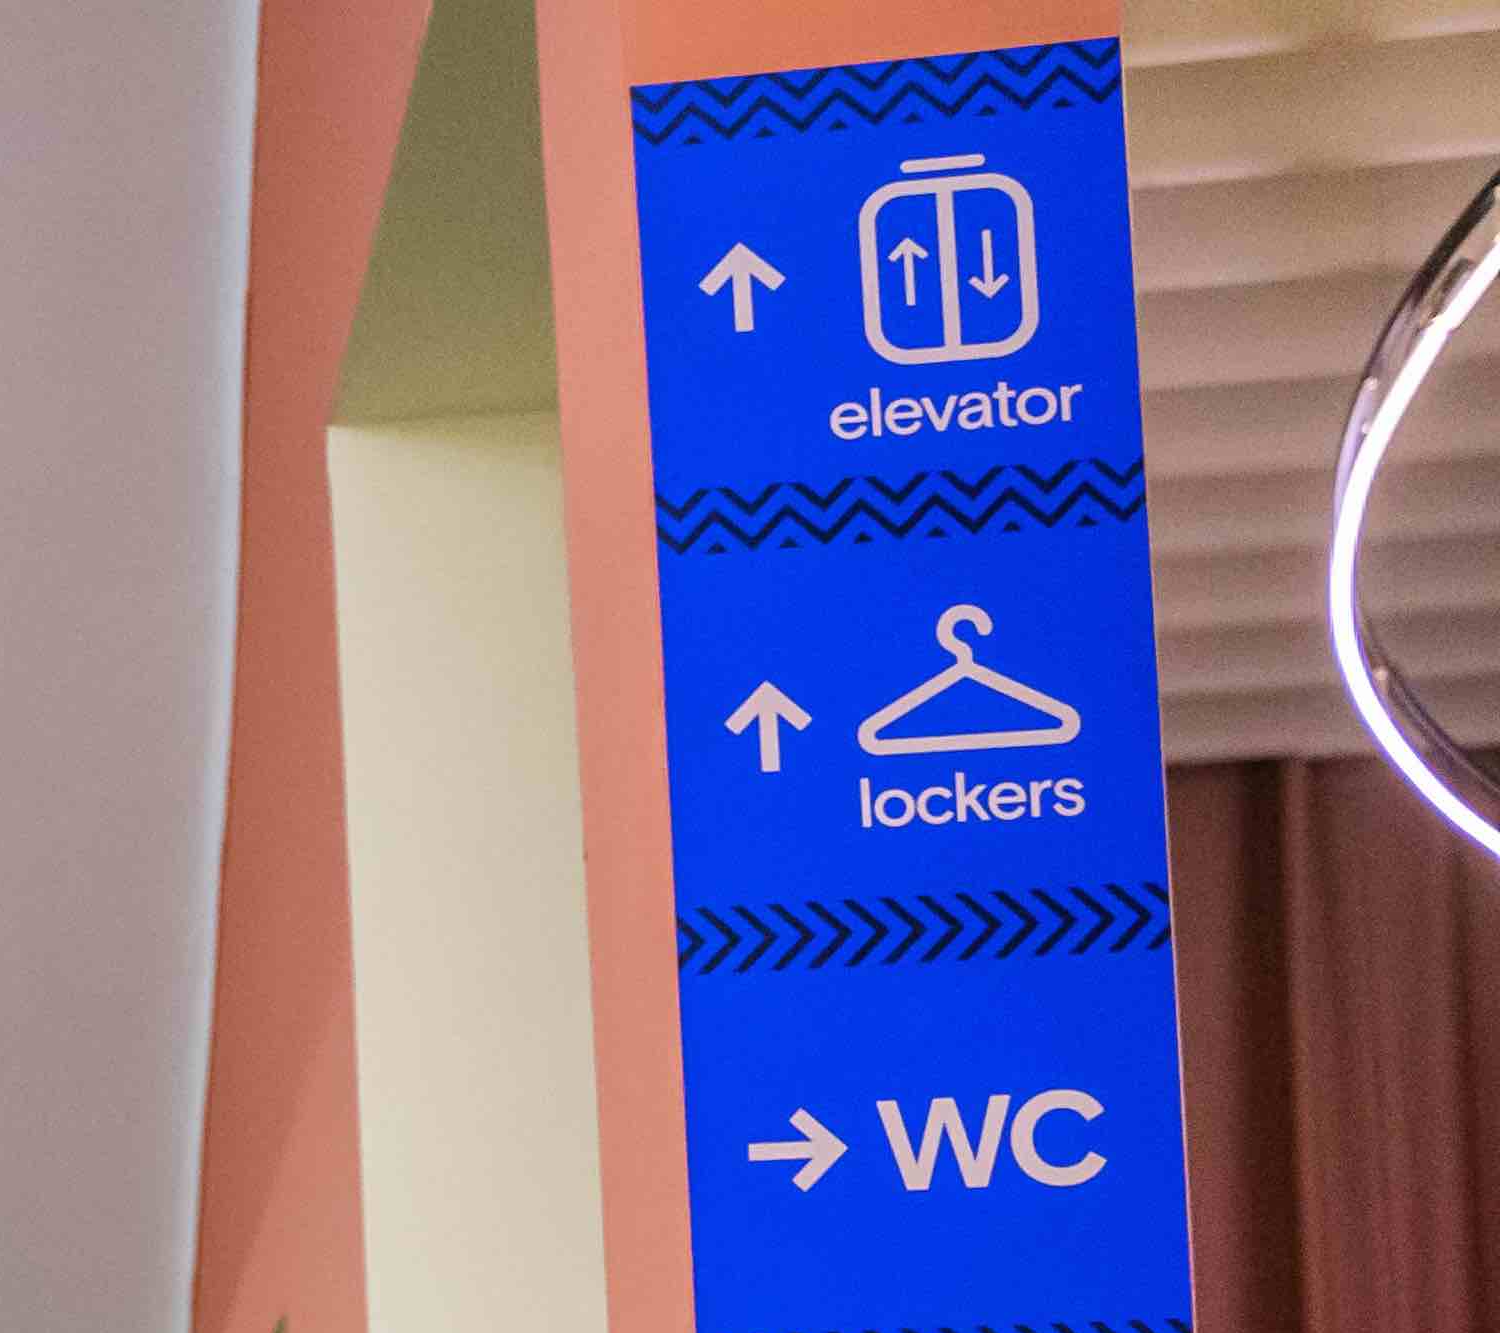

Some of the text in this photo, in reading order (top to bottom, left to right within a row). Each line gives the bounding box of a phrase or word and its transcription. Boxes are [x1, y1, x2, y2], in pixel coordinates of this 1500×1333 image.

[830, 380, 1083, 441] elevator
[860, 772, 1086, 828] lockers
[875, 1088, 1108, 1192] WC
